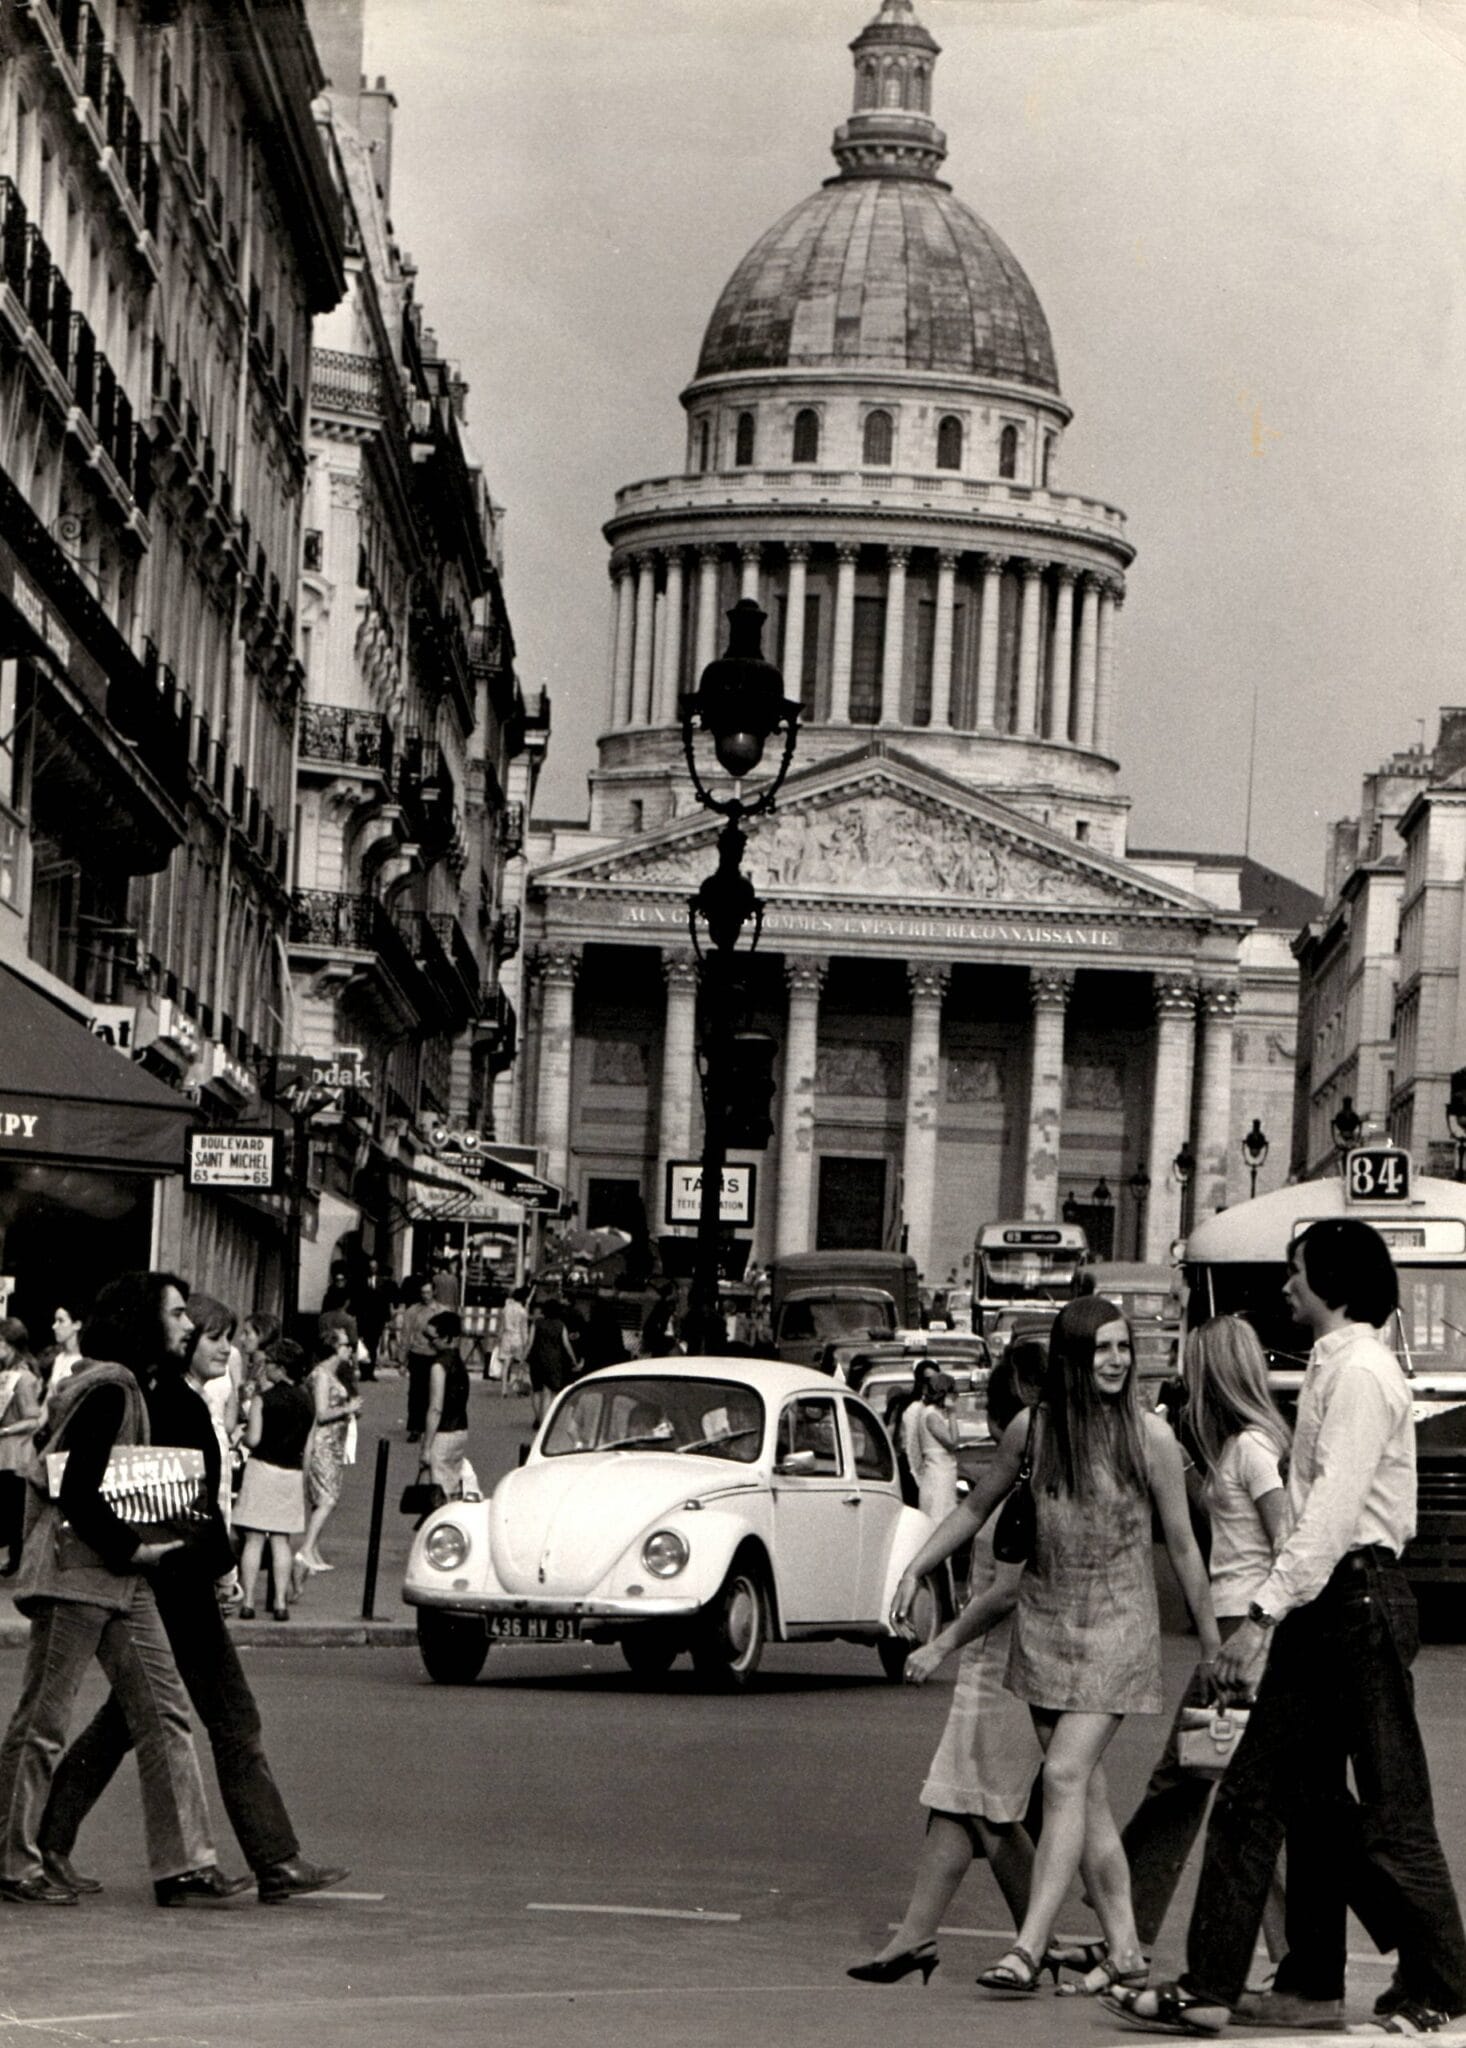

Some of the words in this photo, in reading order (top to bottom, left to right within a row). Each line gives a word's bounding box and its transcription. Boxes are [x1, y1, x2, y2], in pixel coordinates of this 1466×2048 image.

[946, 922, 1114, 946] RECONNAISSANTE
[312, 1062, 371, 1088] odak
[0, 1112, 39, 1138] PY
[200, 1137, 264, 1151] BOULEVARD
[195, 1152, 224, 1168] SAINT
[230, 1153, 269, 1169] MICHEL
[193, 1170, 208, 1182] 63
[253, 1171, 269, 1184] 65
[682, 1177, 740, 1193] TAIS
[1352, 1157, 1403, 1194] 84
[677, 1199, 696, 1209] TETE
[491, 1617, 522, 1636] 436
[528, 1618, 548, 1637] HV
[555, 1620, 574, 1639] 91
